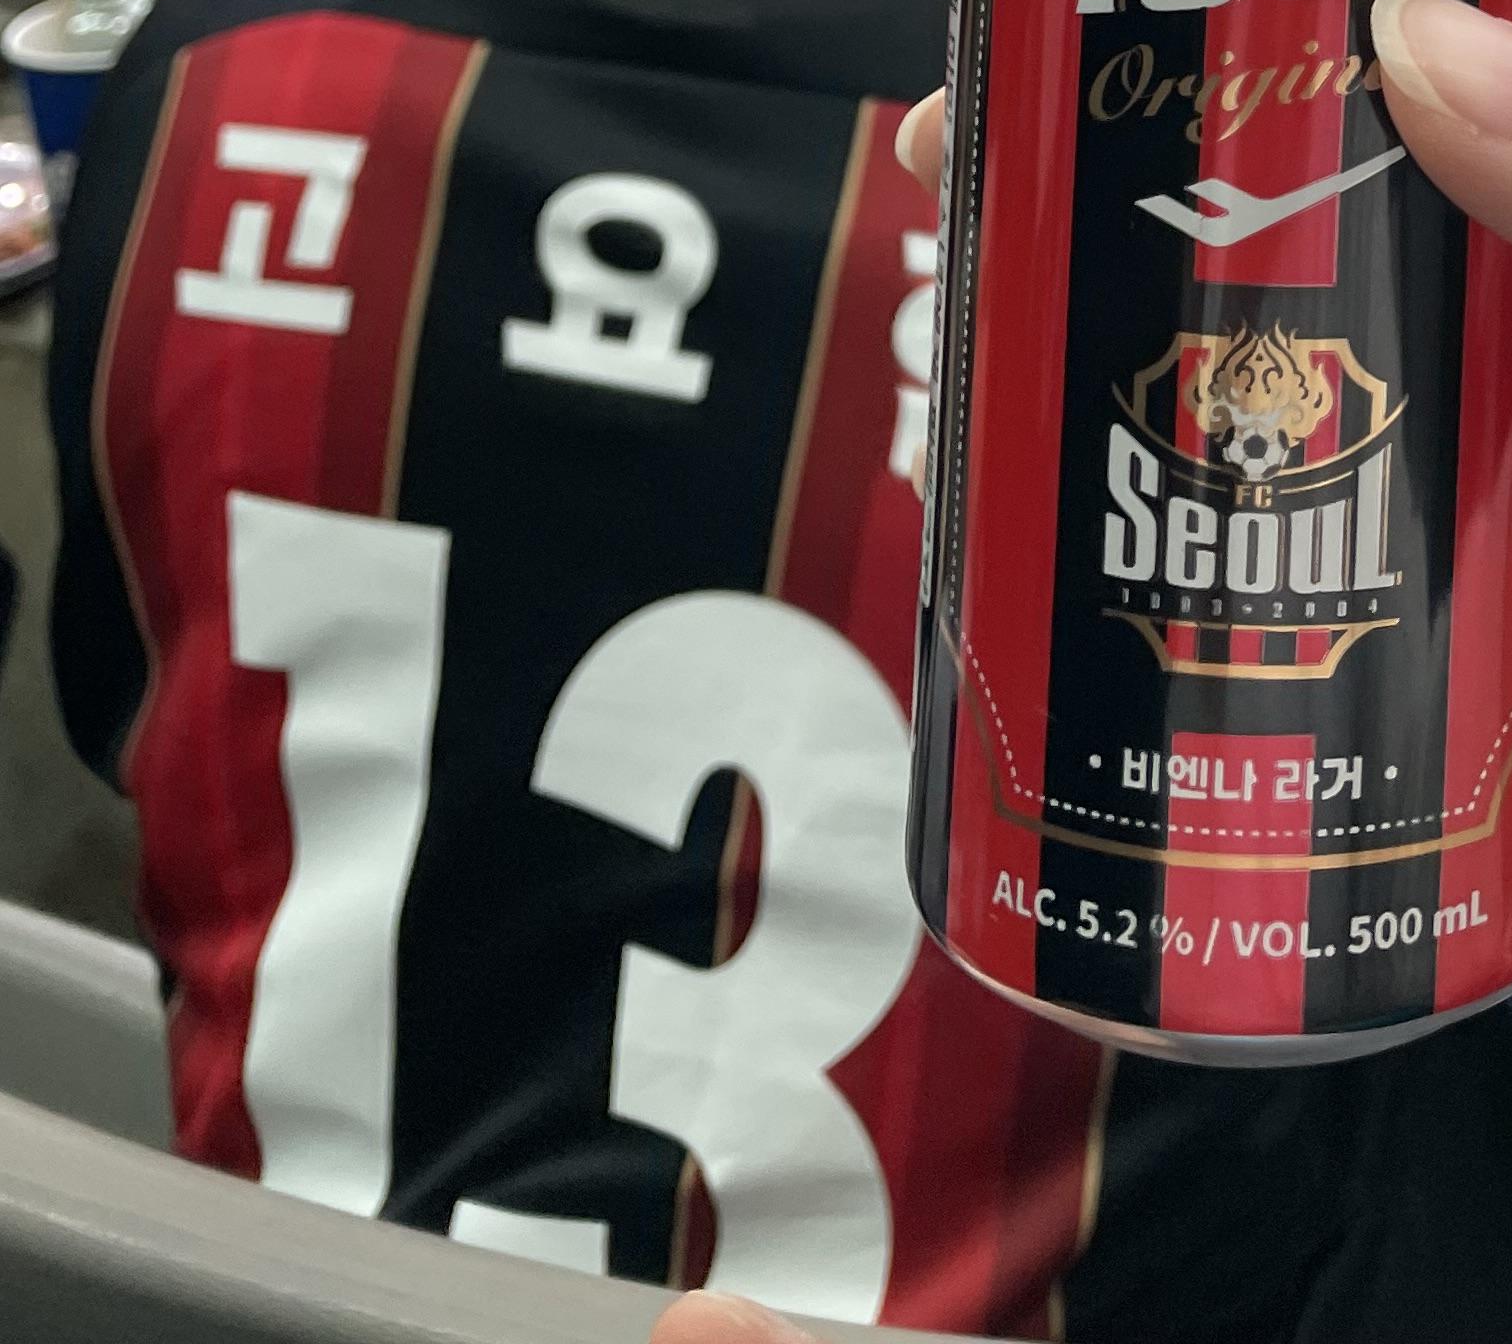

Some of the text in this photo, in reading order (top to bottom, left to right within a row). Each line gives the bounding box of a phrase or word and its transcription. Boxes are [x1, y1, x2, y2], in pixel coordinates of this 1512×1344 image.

[1088, 39, 1381, 144] Origin
[1235, 484, 1273, 508] FC
[1121, 747, 1363, 803] 비엔나 라거
[226, 492, 924, 1330] 13
[992, 869, 1067, 933] ALC.
[1231, 919, 1337, 959] VOL.
[1347, 906, 1424, 955] 500
[1432, 888, 1489, 937] mL
